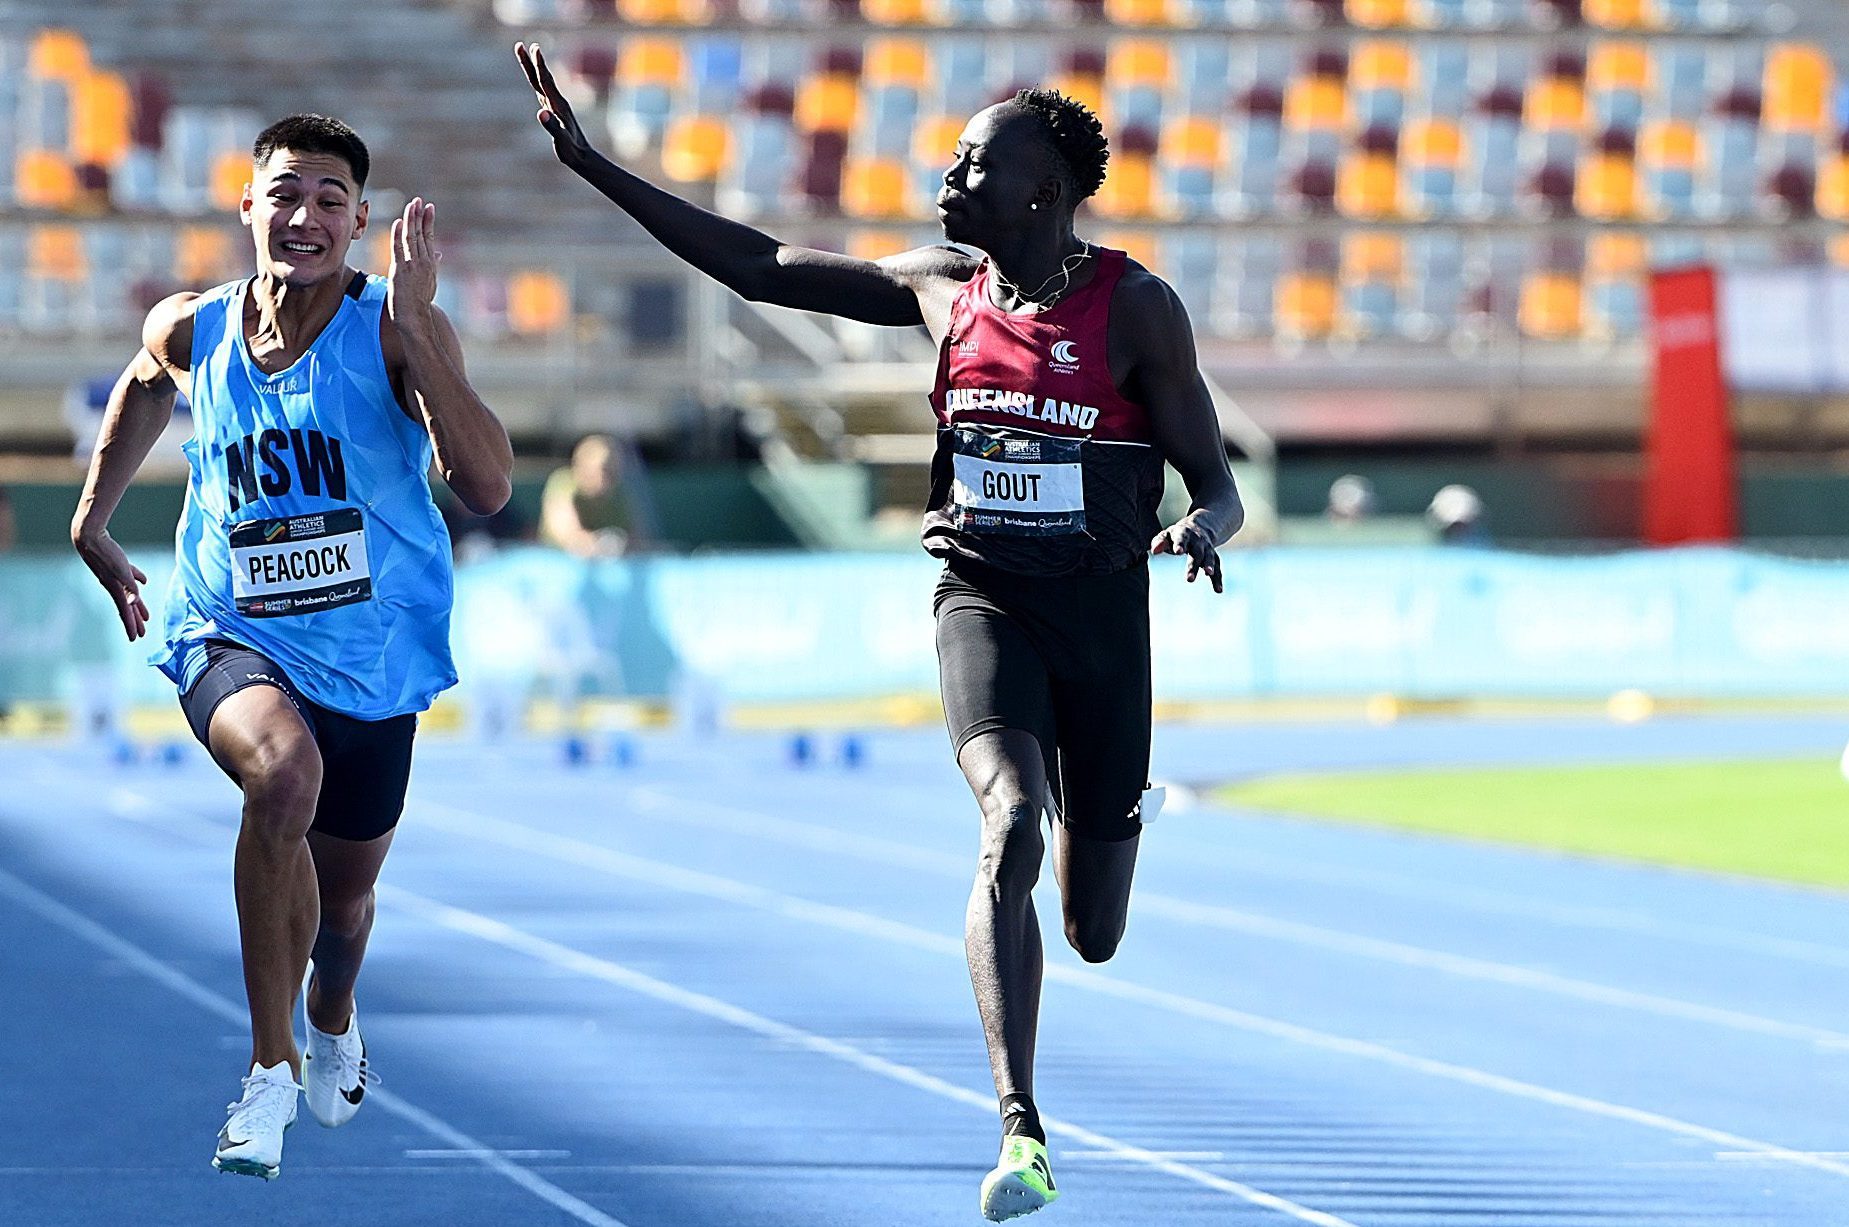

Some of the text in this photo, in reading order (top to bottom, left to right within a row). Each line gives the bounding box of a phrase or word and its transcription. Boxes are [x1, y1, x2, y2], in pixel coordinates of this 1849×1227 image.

[945, 388, 1100, 430] QUEENSLAND
[225, 428, 347, 514] NSW
[982, 470, 1042, 502] GOUT
[289, 515, 324, 525] AUSTRALIAN
[289, 520, 325, 530] ATHLETICS
[1004, 517, 1037, 527] brisbane
[248, 543, 351, 585] PEACOCK
[294, 596, 328, 606] brisbane
